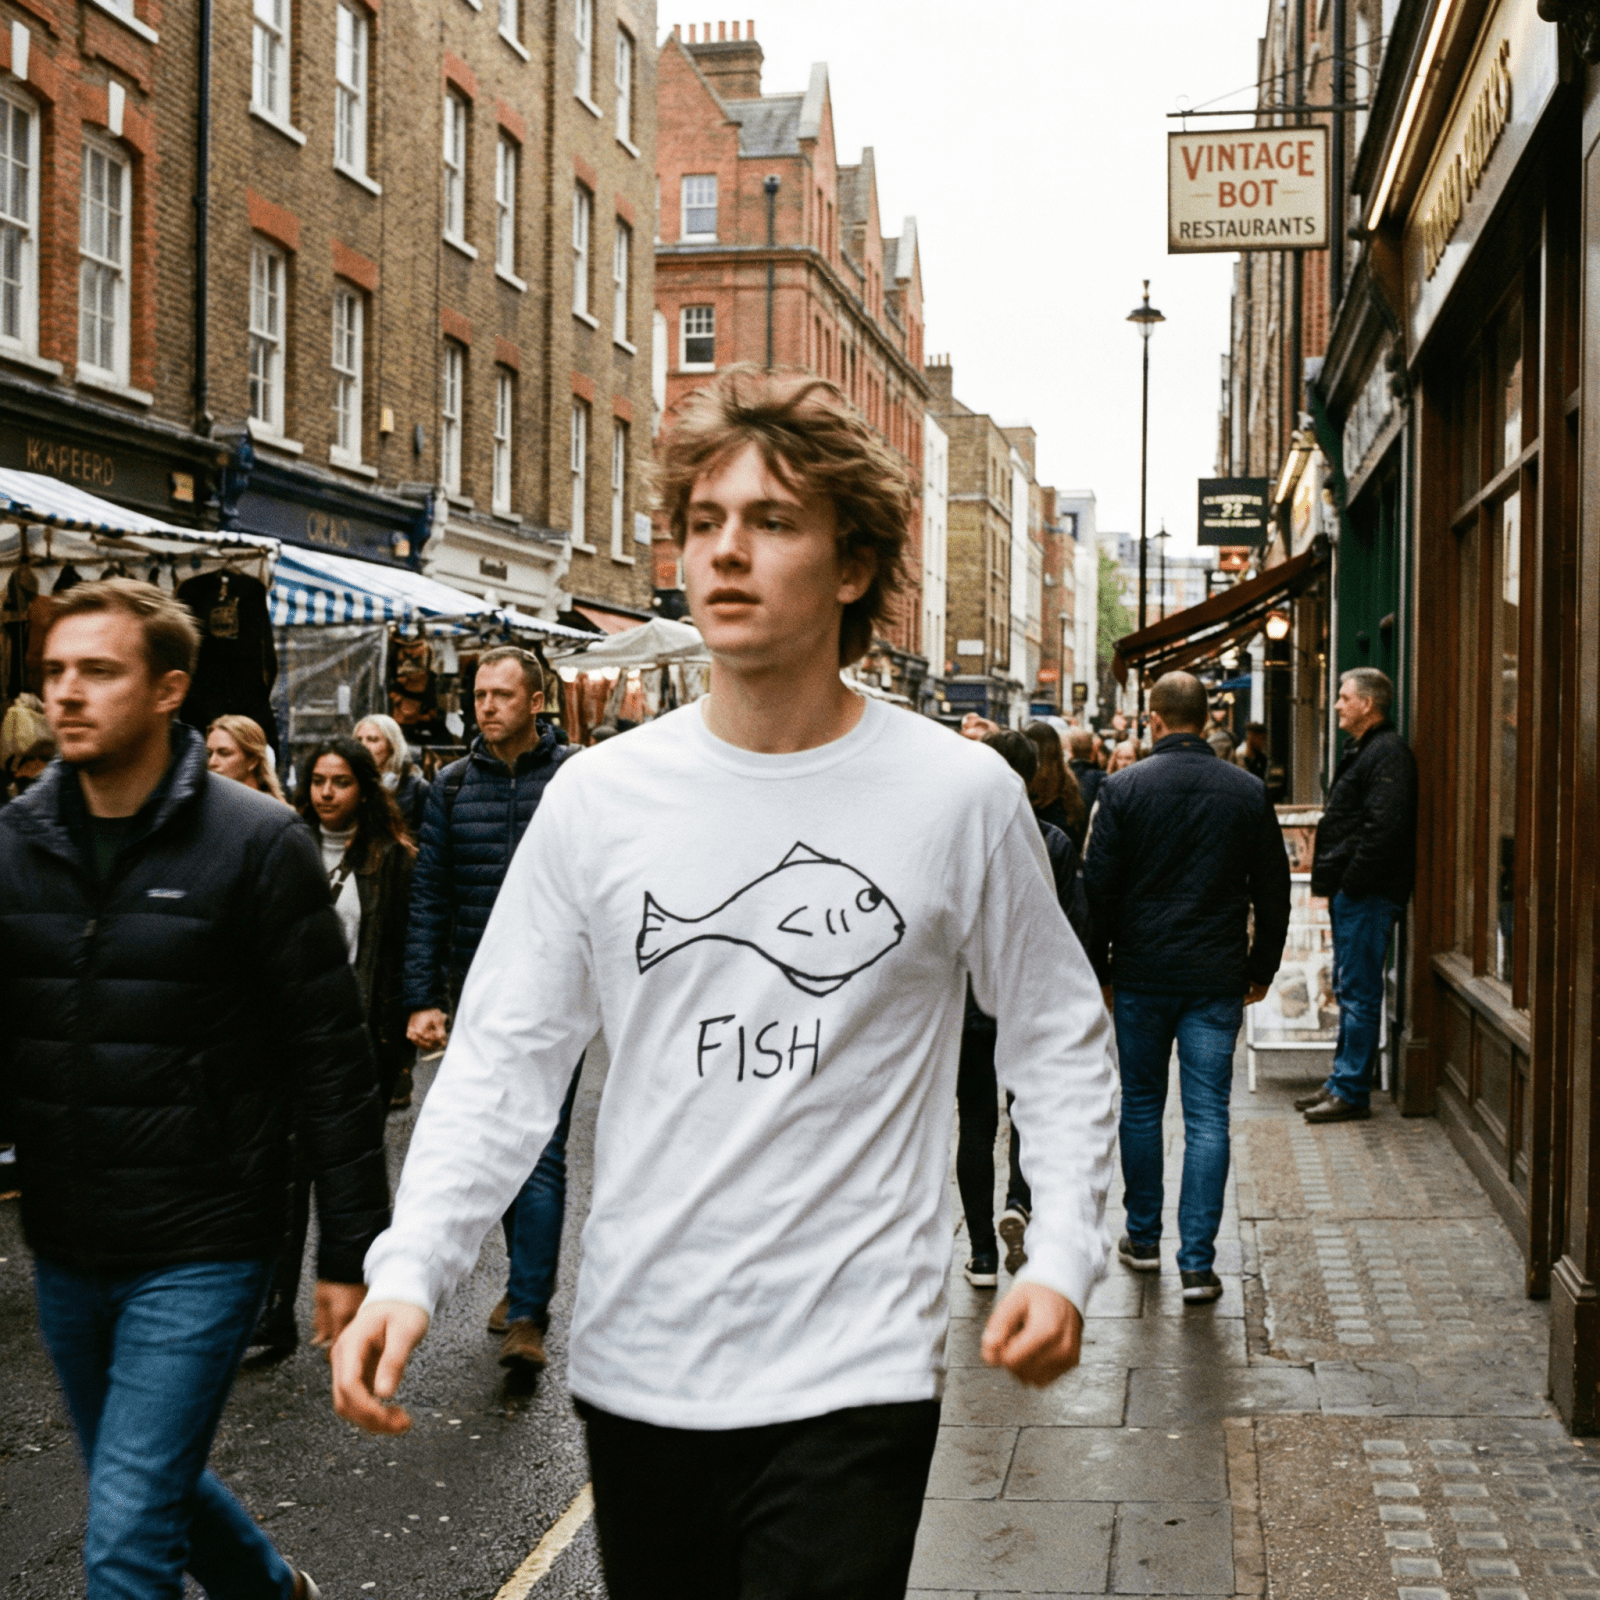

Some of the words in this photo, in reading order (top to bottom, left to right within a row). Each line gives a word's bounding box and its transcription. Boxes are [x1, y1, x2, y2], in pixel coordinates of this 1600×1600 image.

[1180, 140, 1315, 181] VINTAGE
[1218, 179, 1278, 208] BOT
[1179, 216, 1316, 239] RESTAURANTS
[697, 1014, 821, 1082] FISH
